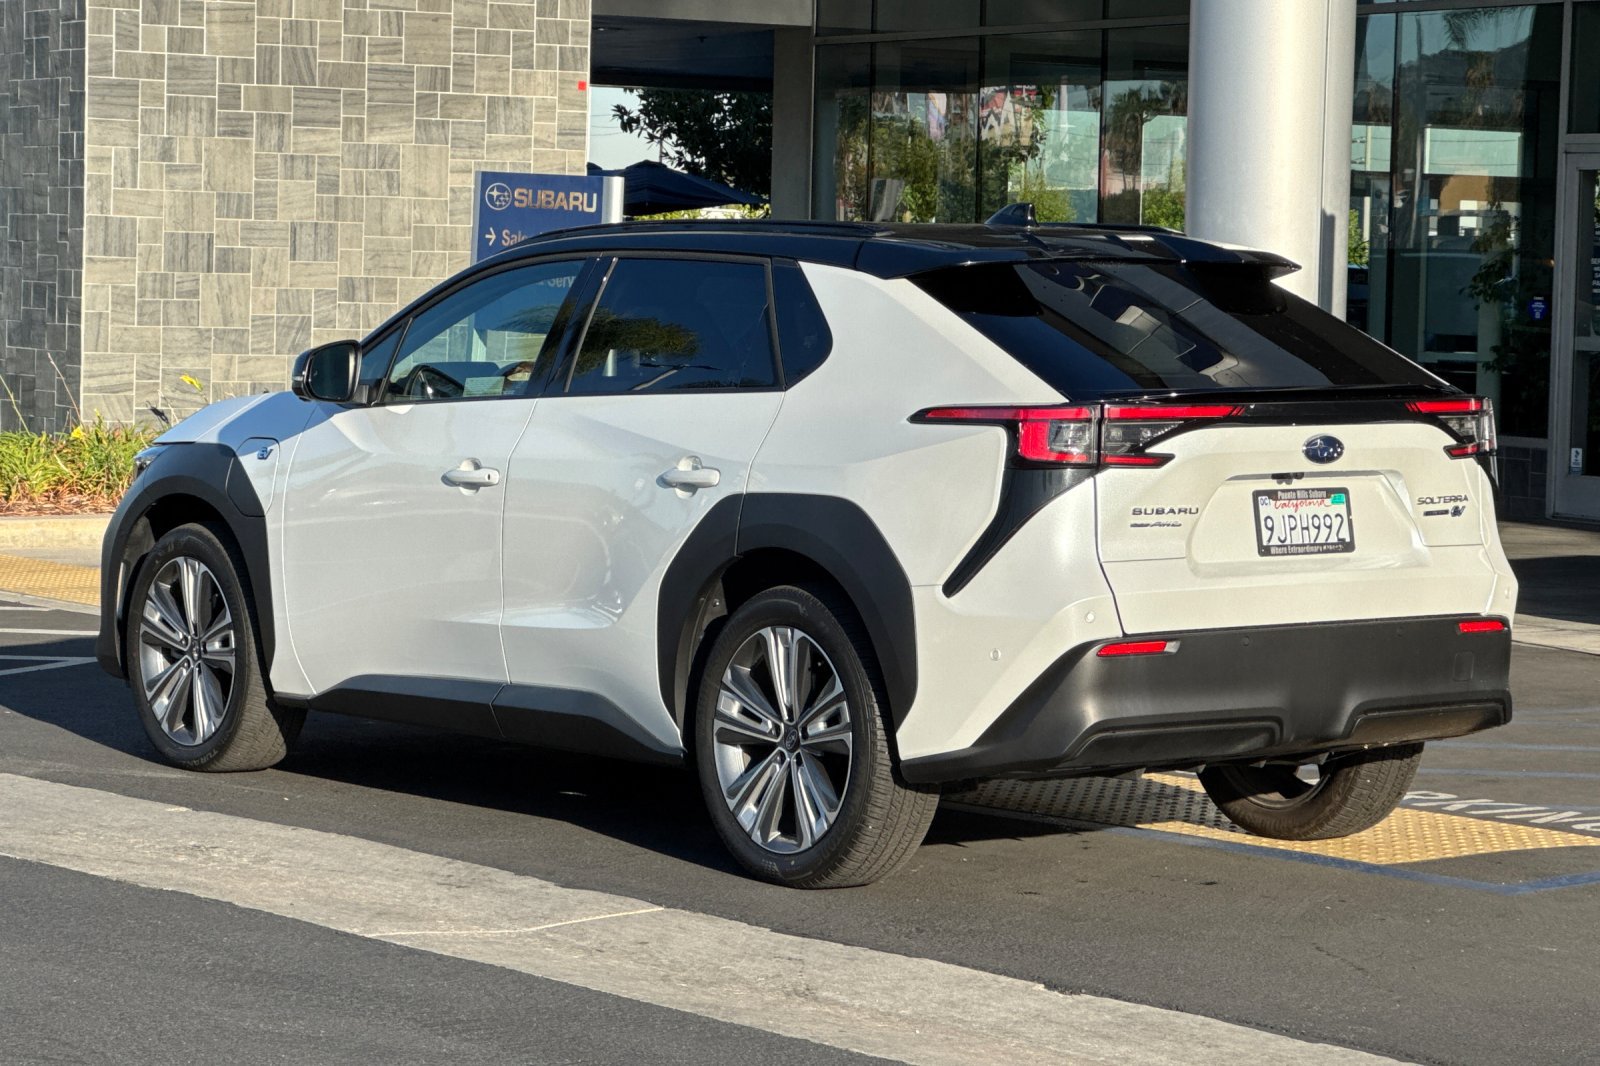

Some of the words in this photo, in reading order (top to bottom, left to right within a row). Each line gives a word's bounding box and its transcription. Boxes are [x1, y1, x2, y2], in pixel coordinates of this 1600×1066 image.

[514, 188, 598, 213] SUBARU
[1417, 494, 1469, 505] SOLTERRA
[1131, 507, 1199, 516] SUBARU
[1263, 513, 1346, 545] 9JPH992
